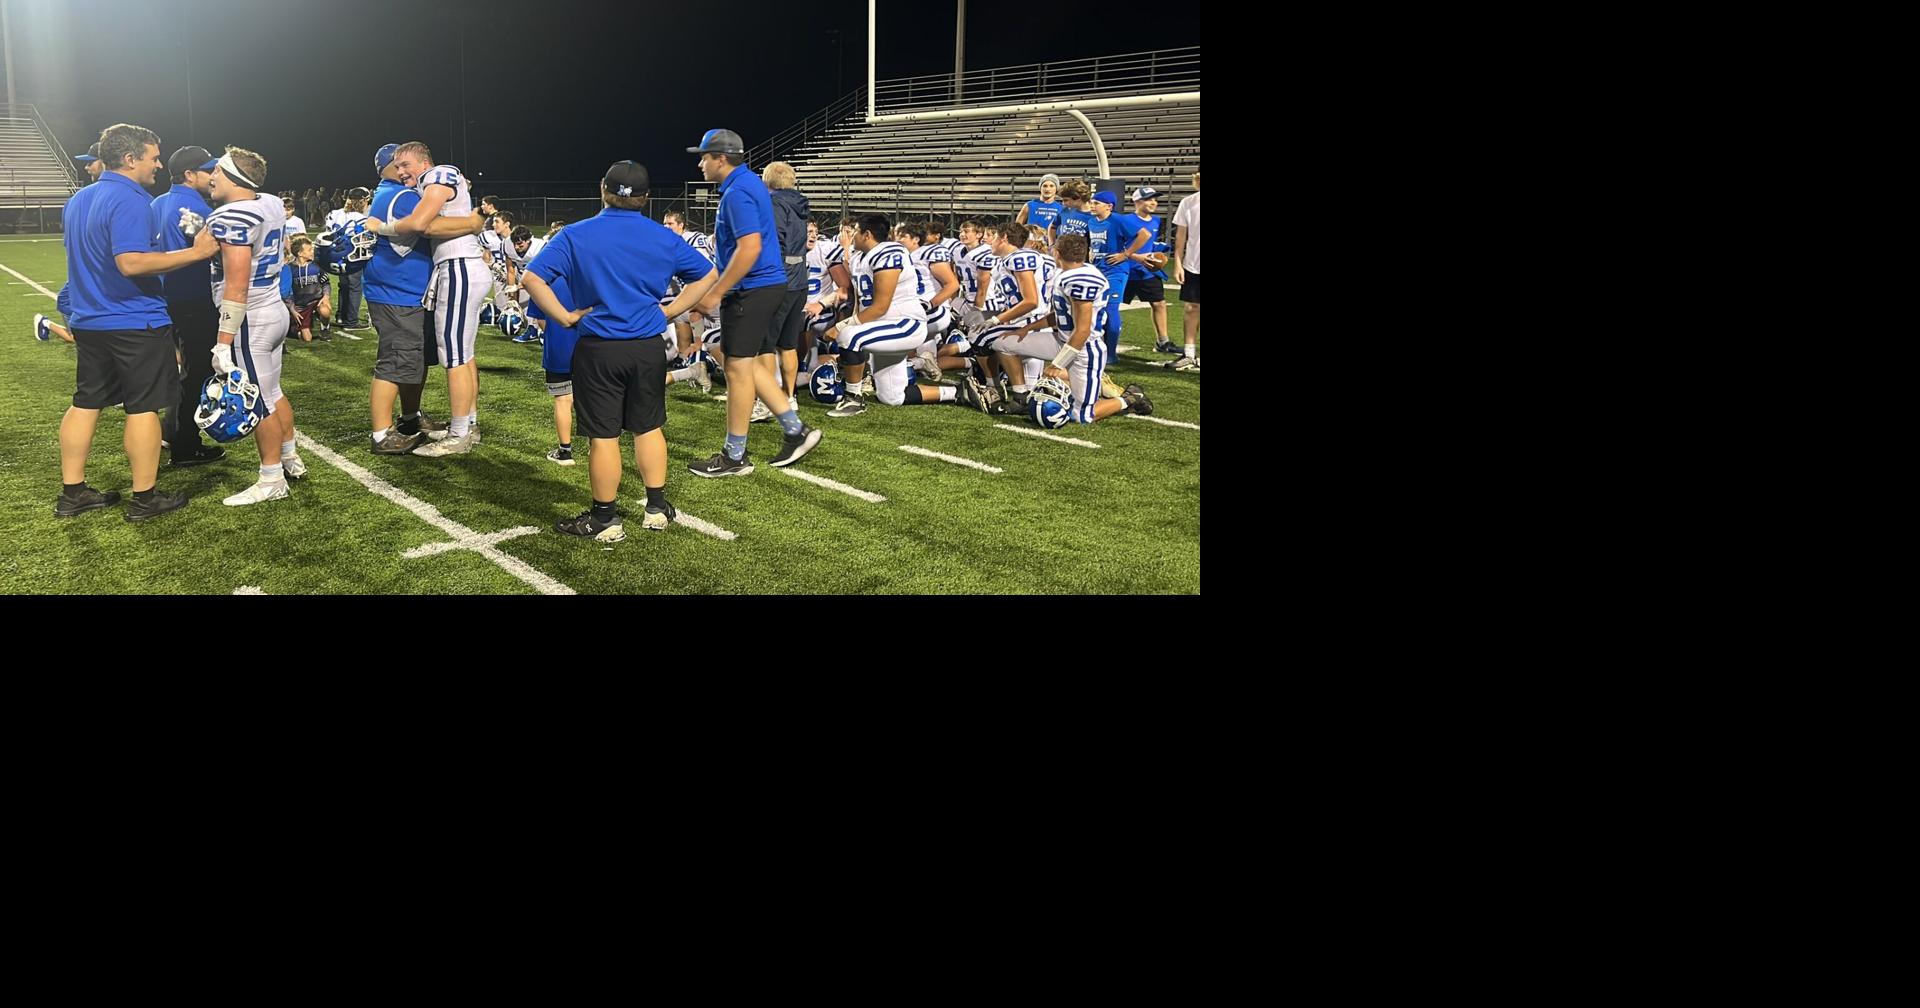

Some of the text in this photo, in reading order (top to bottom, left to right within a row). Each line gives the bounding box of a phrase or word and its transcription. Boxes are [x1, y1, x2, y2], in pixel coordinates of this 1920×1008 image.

[434, 170, 459, 186] 15
[211, 223, 249, 244] 23
[252, 228, 286, 288] 2
[1012, 255, 1037, 270] 88
[1069, 283, 1100, 300] 28
[816, 376, 835, 396] M
